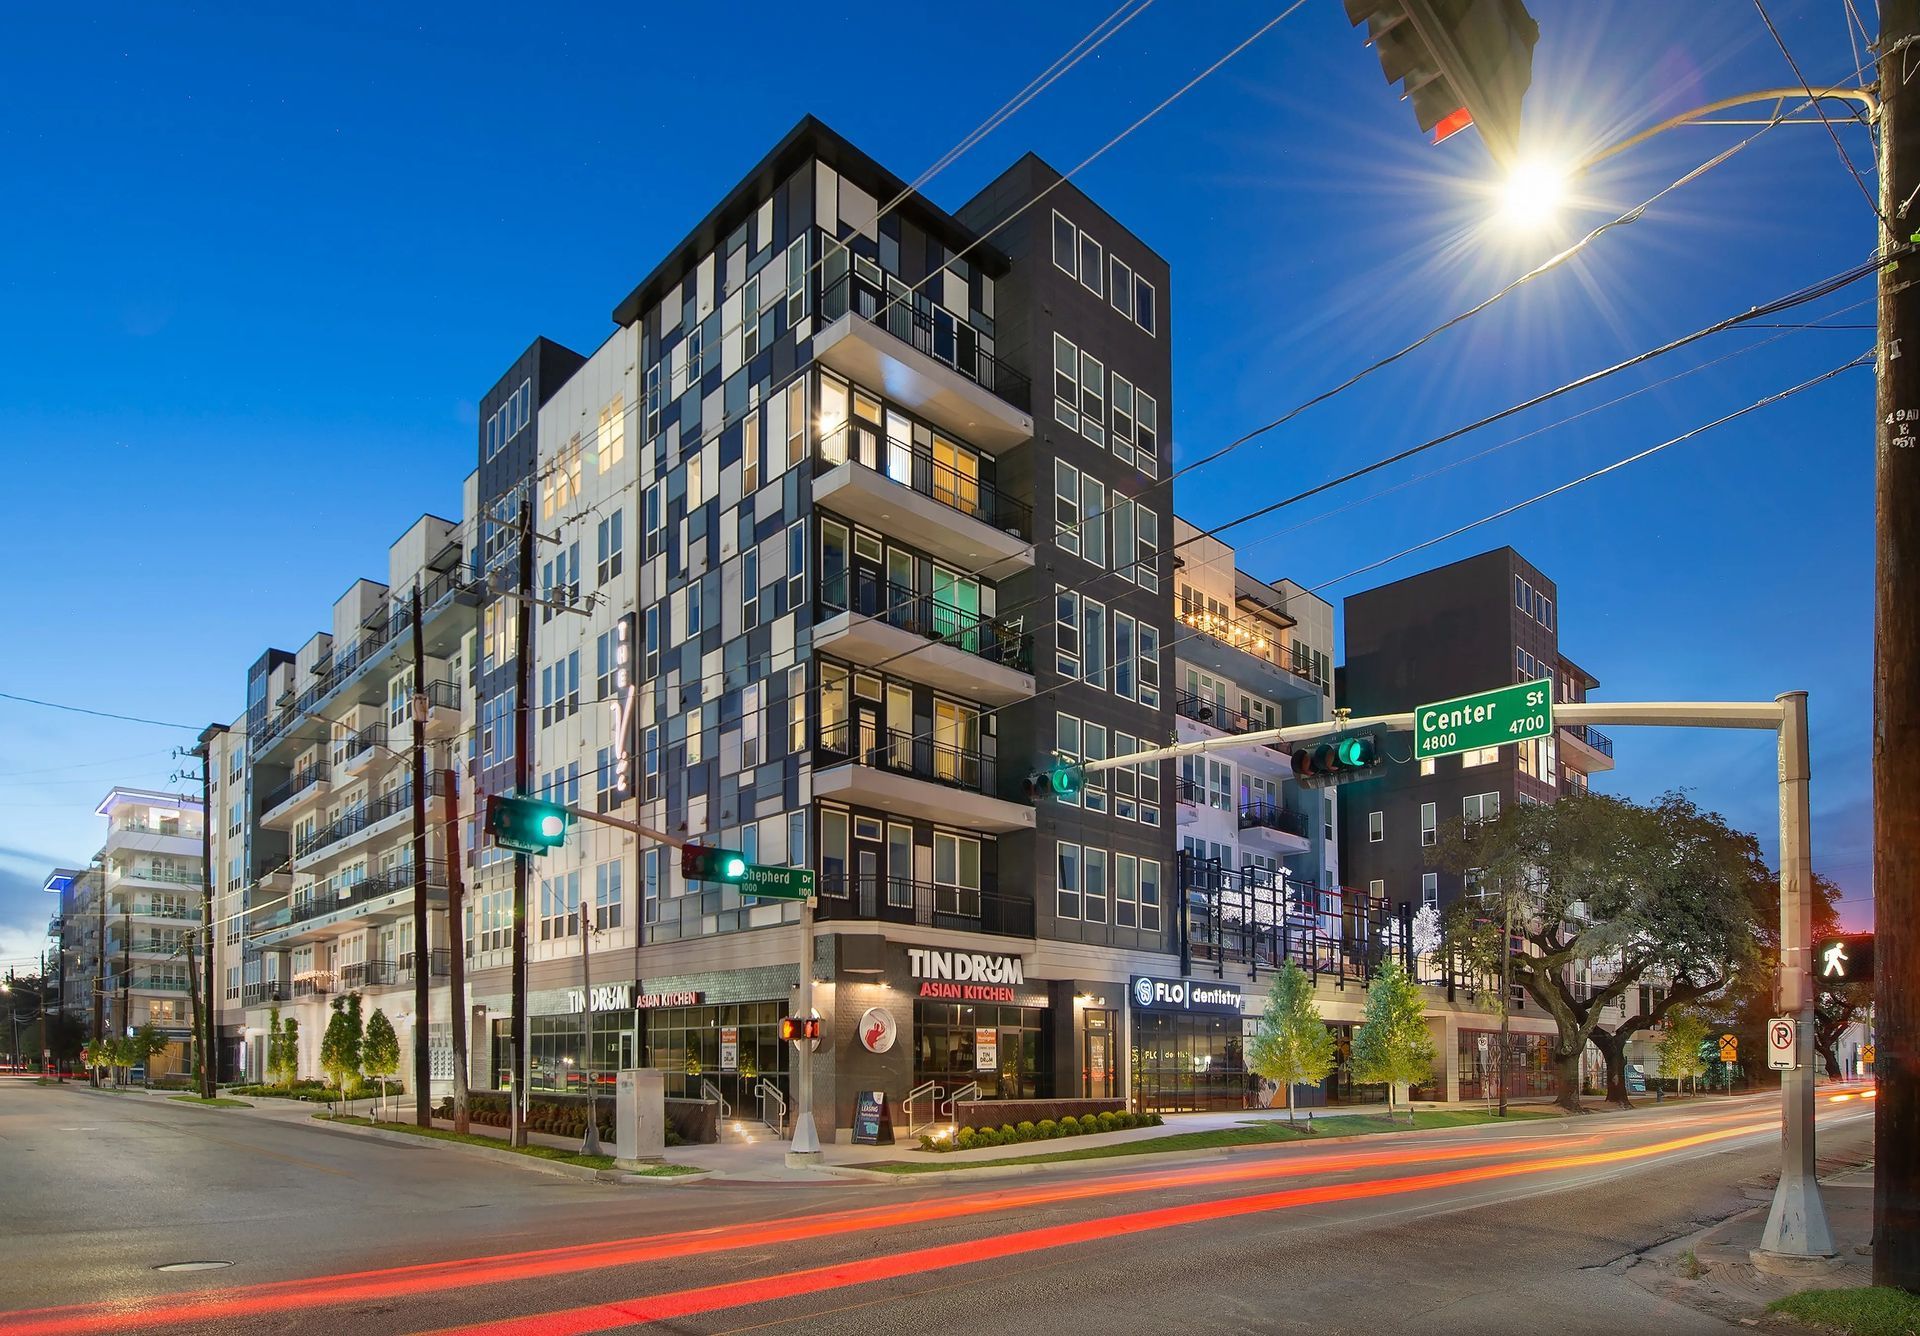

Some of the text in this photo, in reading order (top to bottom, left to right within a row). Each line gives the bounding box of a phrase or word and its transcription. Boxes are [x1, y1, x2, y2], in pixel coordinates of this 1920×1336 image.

[1422, 690, 1544, 732] Center St
[1422, 715, 1544, 751] 4800 4700
[742, 882, 812, 896] 1000 1100
[743, 868, 811, 884] Shepherd Dr
[908, 948, 1024, 985] TIN DRUM
[590, 985, 631, 1012] DRUM
[636, 995, 660, 1008] ASIAN
[661, 991, 697, 1006] KITCHEN
[920, 982, 1014, 1001] ASIAN KITCHEN
[1154, 982, 1242, 1009] FLO dentistry
[1618, 993, 1626, 1018] 201
